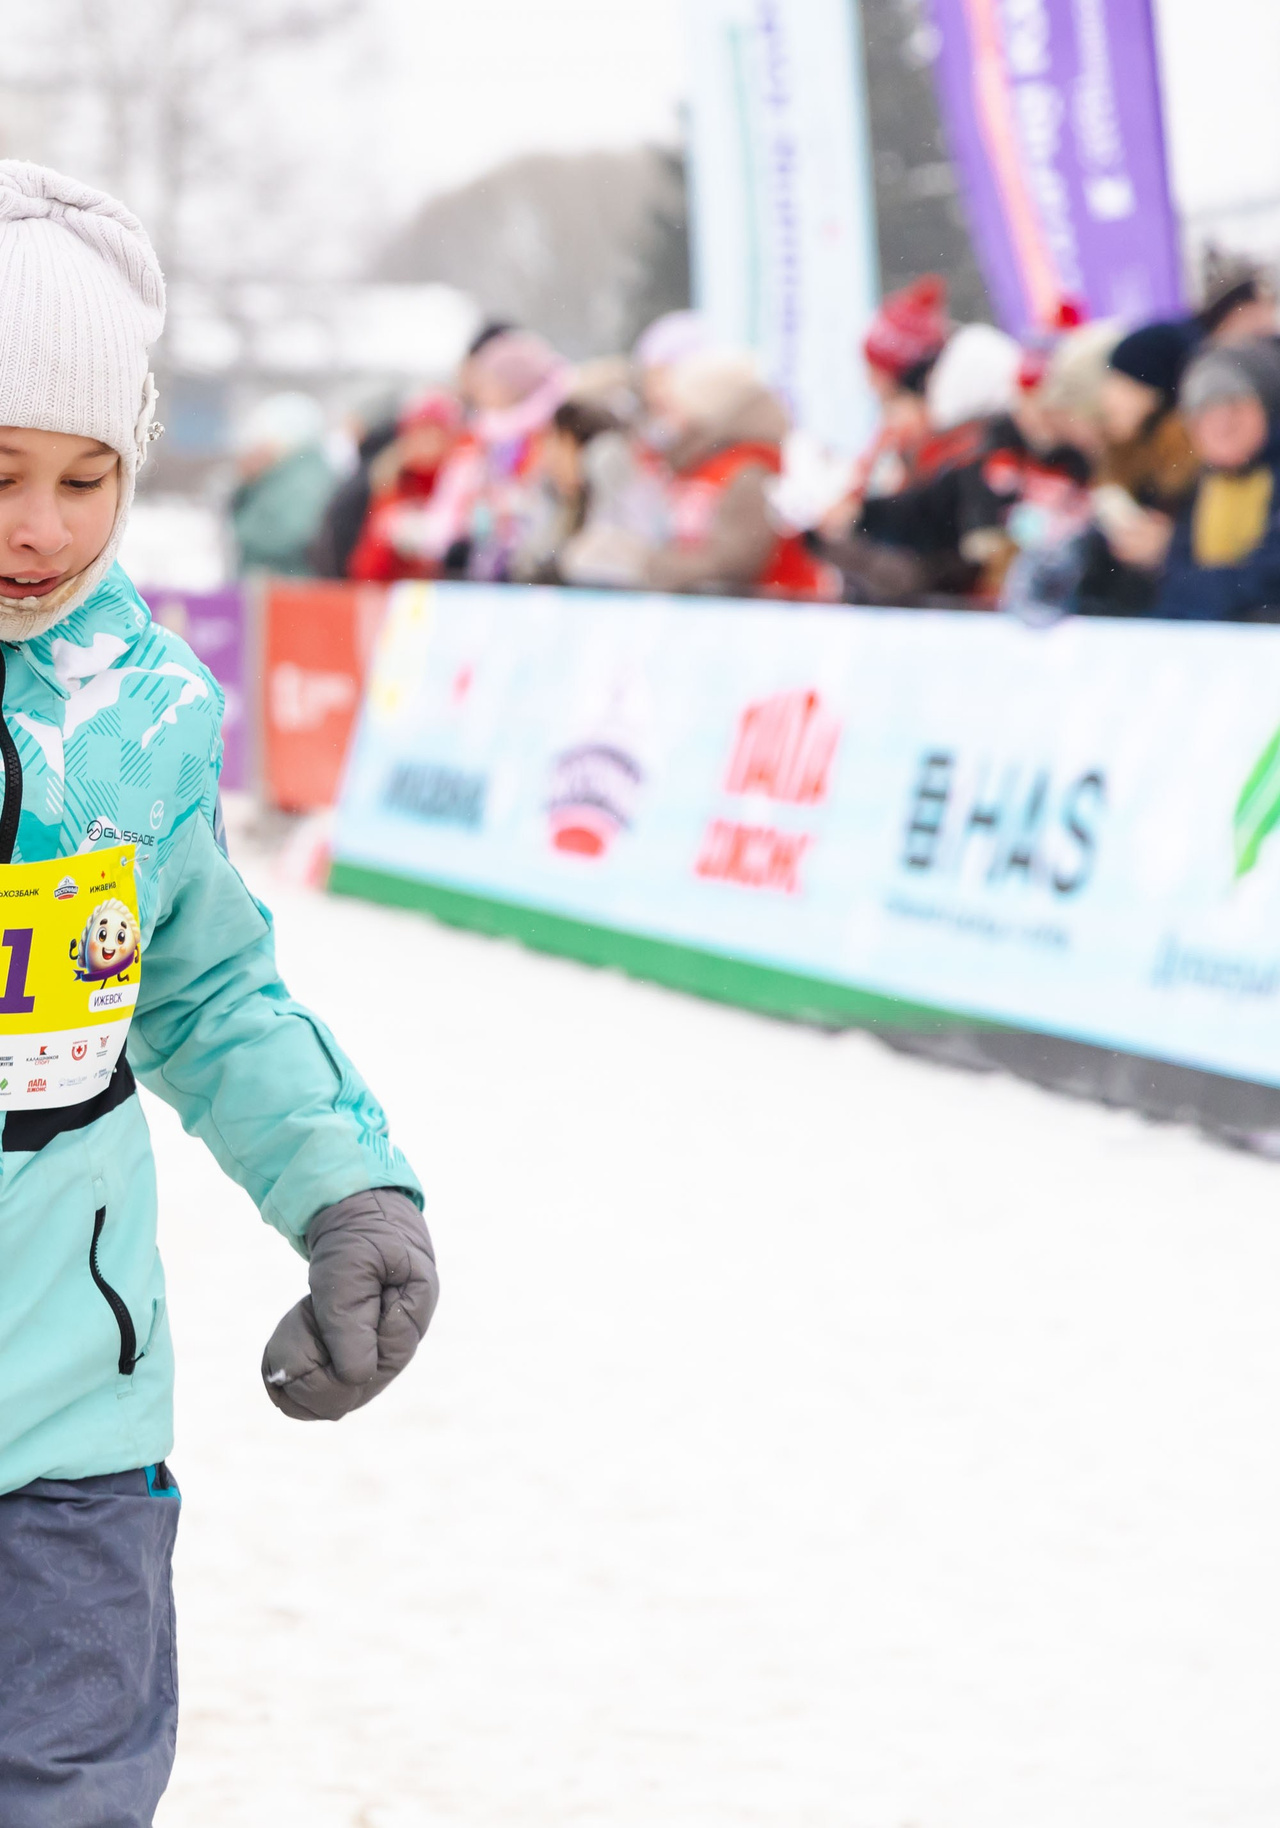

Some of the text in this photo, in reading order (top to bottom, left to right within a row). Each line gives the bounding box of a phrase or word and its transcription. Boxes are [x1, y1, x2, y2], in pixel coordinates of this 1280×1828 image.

[104, 827, 155, 846] GLISSADE
[93, 992, 123, 1007] ИЖЕВСК
[28, 1078, 47, 1087] ПАПА
